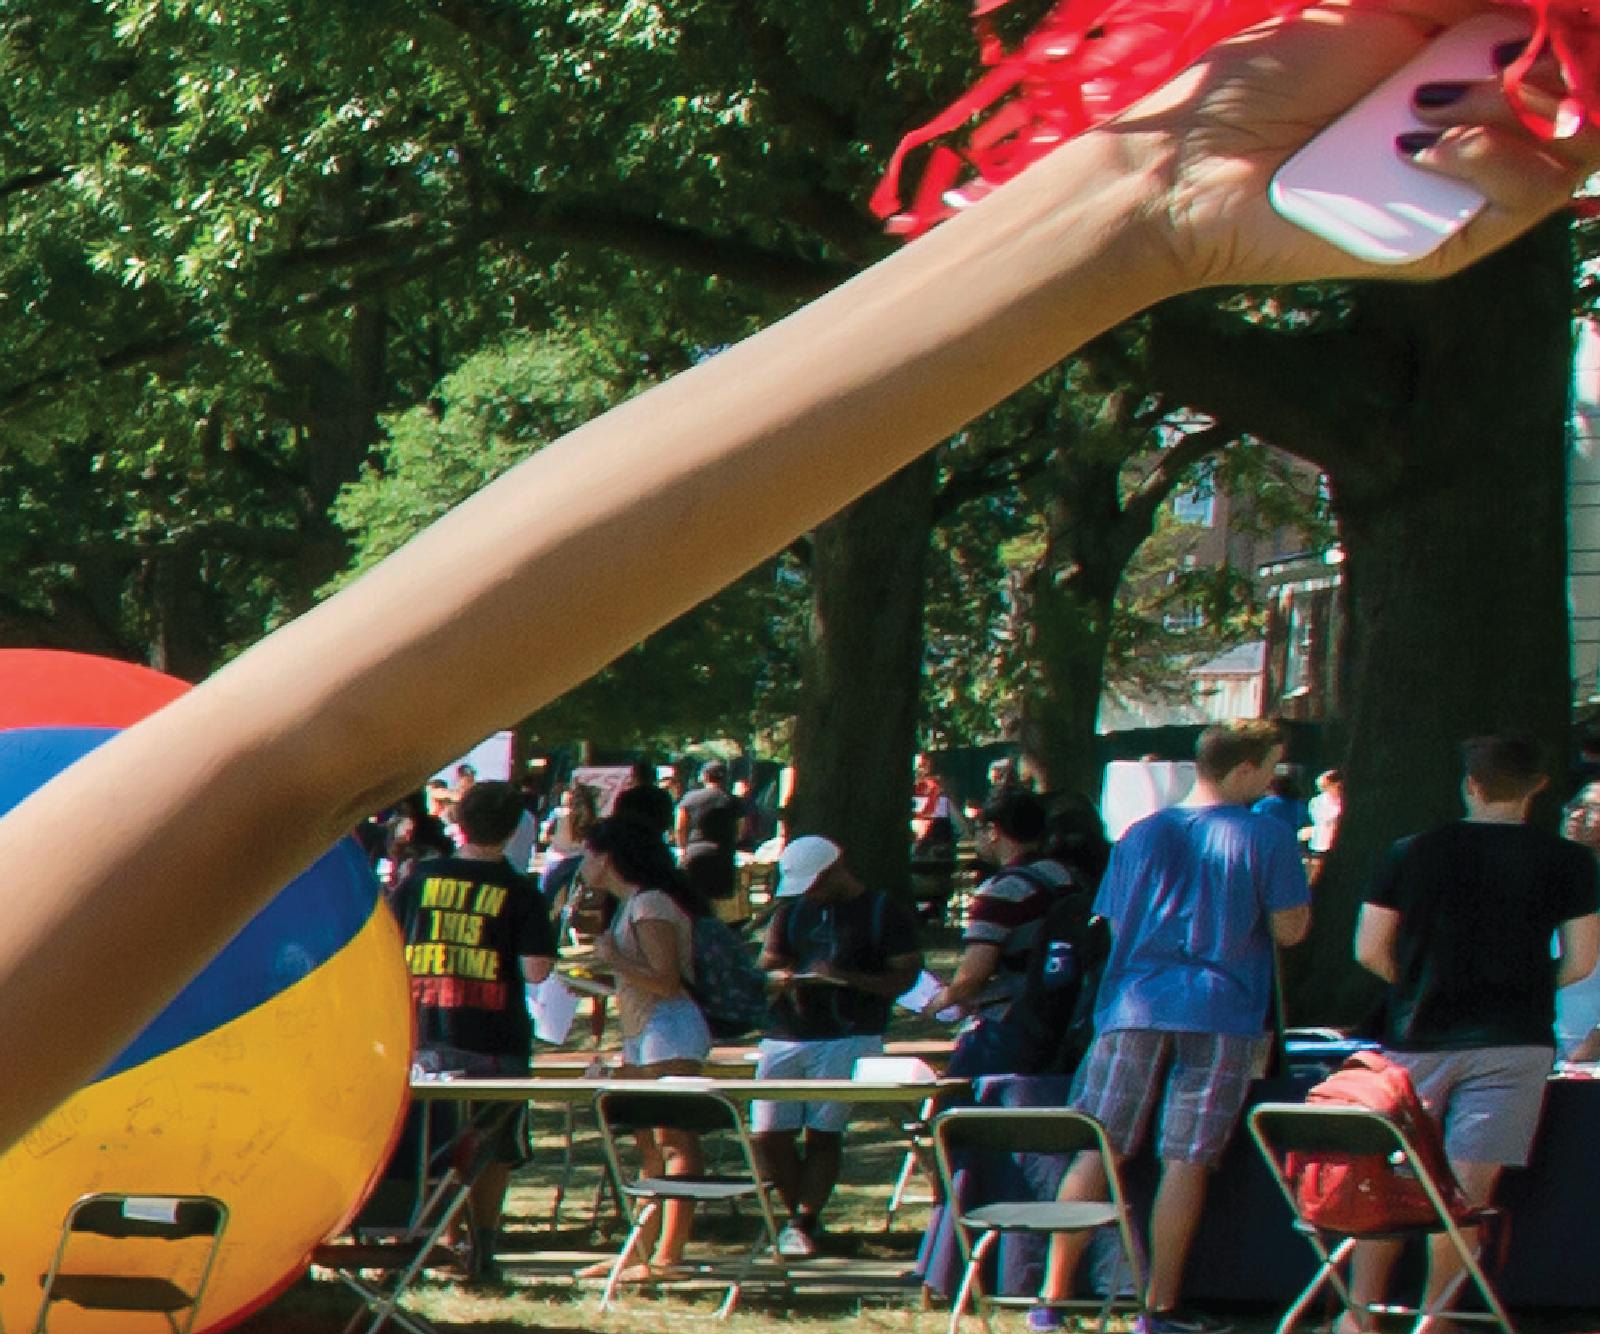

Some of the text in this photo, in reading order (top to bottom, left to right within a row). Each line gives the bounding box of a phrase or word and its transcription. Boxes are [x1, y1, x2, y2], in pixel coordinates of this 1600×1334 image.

[420, 877, 508, 917] NOT IN
[426, 909, 484, 946] THIS
